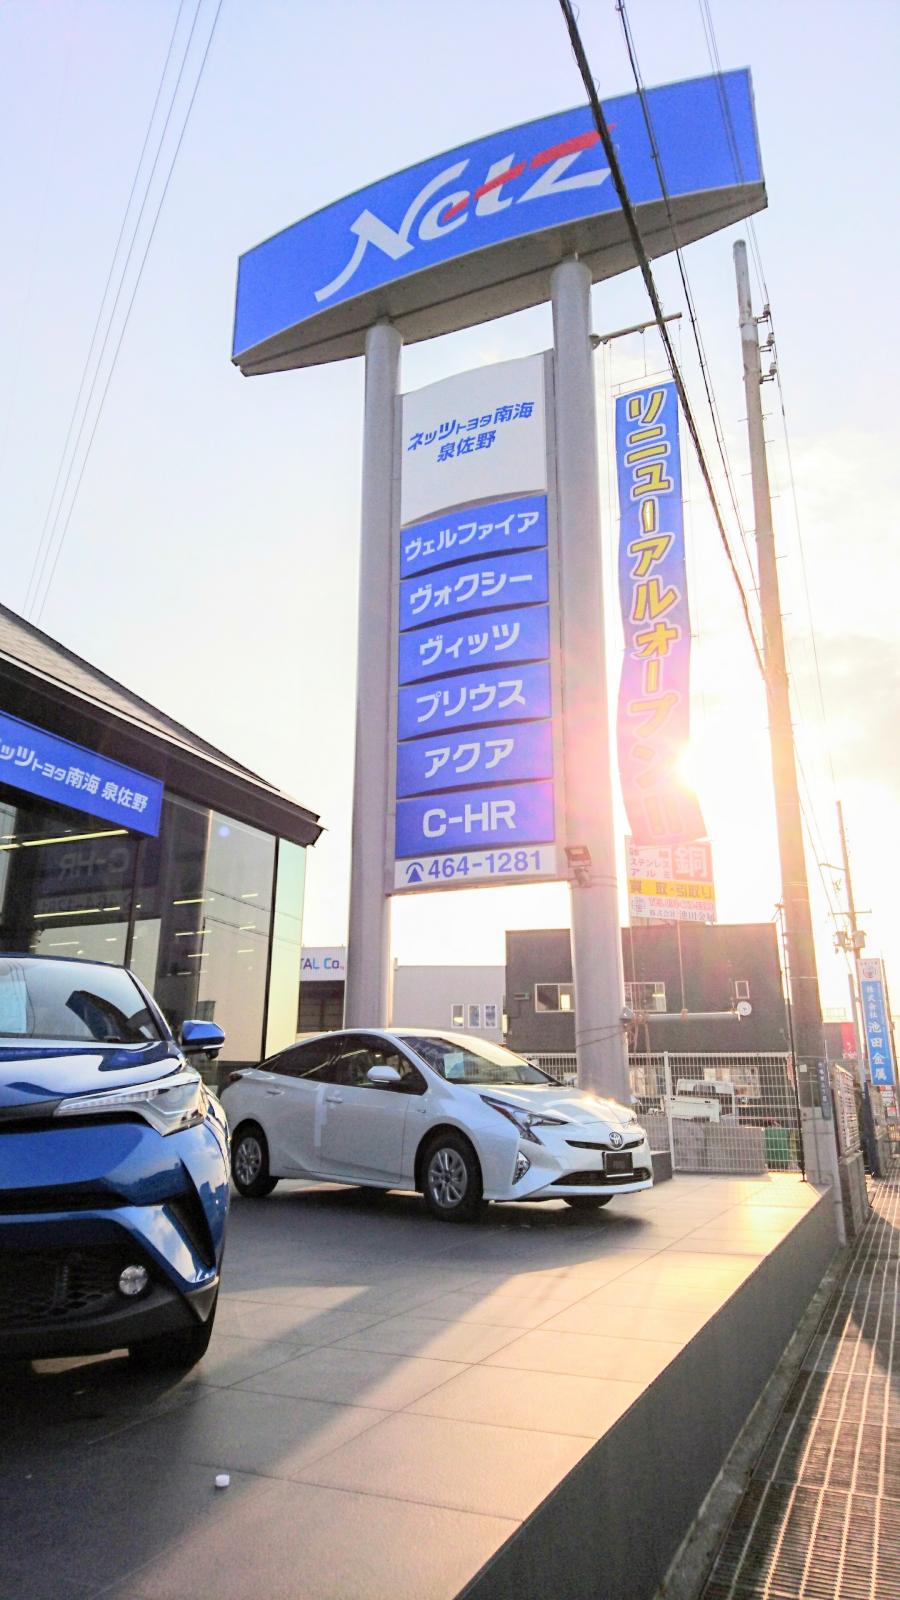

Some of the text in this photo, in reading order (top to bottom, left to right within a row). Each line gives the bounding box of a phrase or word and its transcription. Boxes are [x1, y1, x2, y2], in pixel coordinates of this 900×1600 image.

[315, 124, 617, 302] Netz
[407, 401, 534, 451] ネッツトヨタ南海
[437, 430, 496, 463] 泉佐野
[404, 511, 540, 561] ヴェルファイア
[410, 571, 532, 614] ヴォクシー
[419, 622, 521, 666] ヴィッツ
[416, 679, 526, 722] プリウス
[0, 739, 149, 813] ッツトヨタ南海 泉佐野
[424, 738, 514, 779] アクア
[423, 800, 517, 838] C-HR
[428, 850, 541, 880] 464-1281
